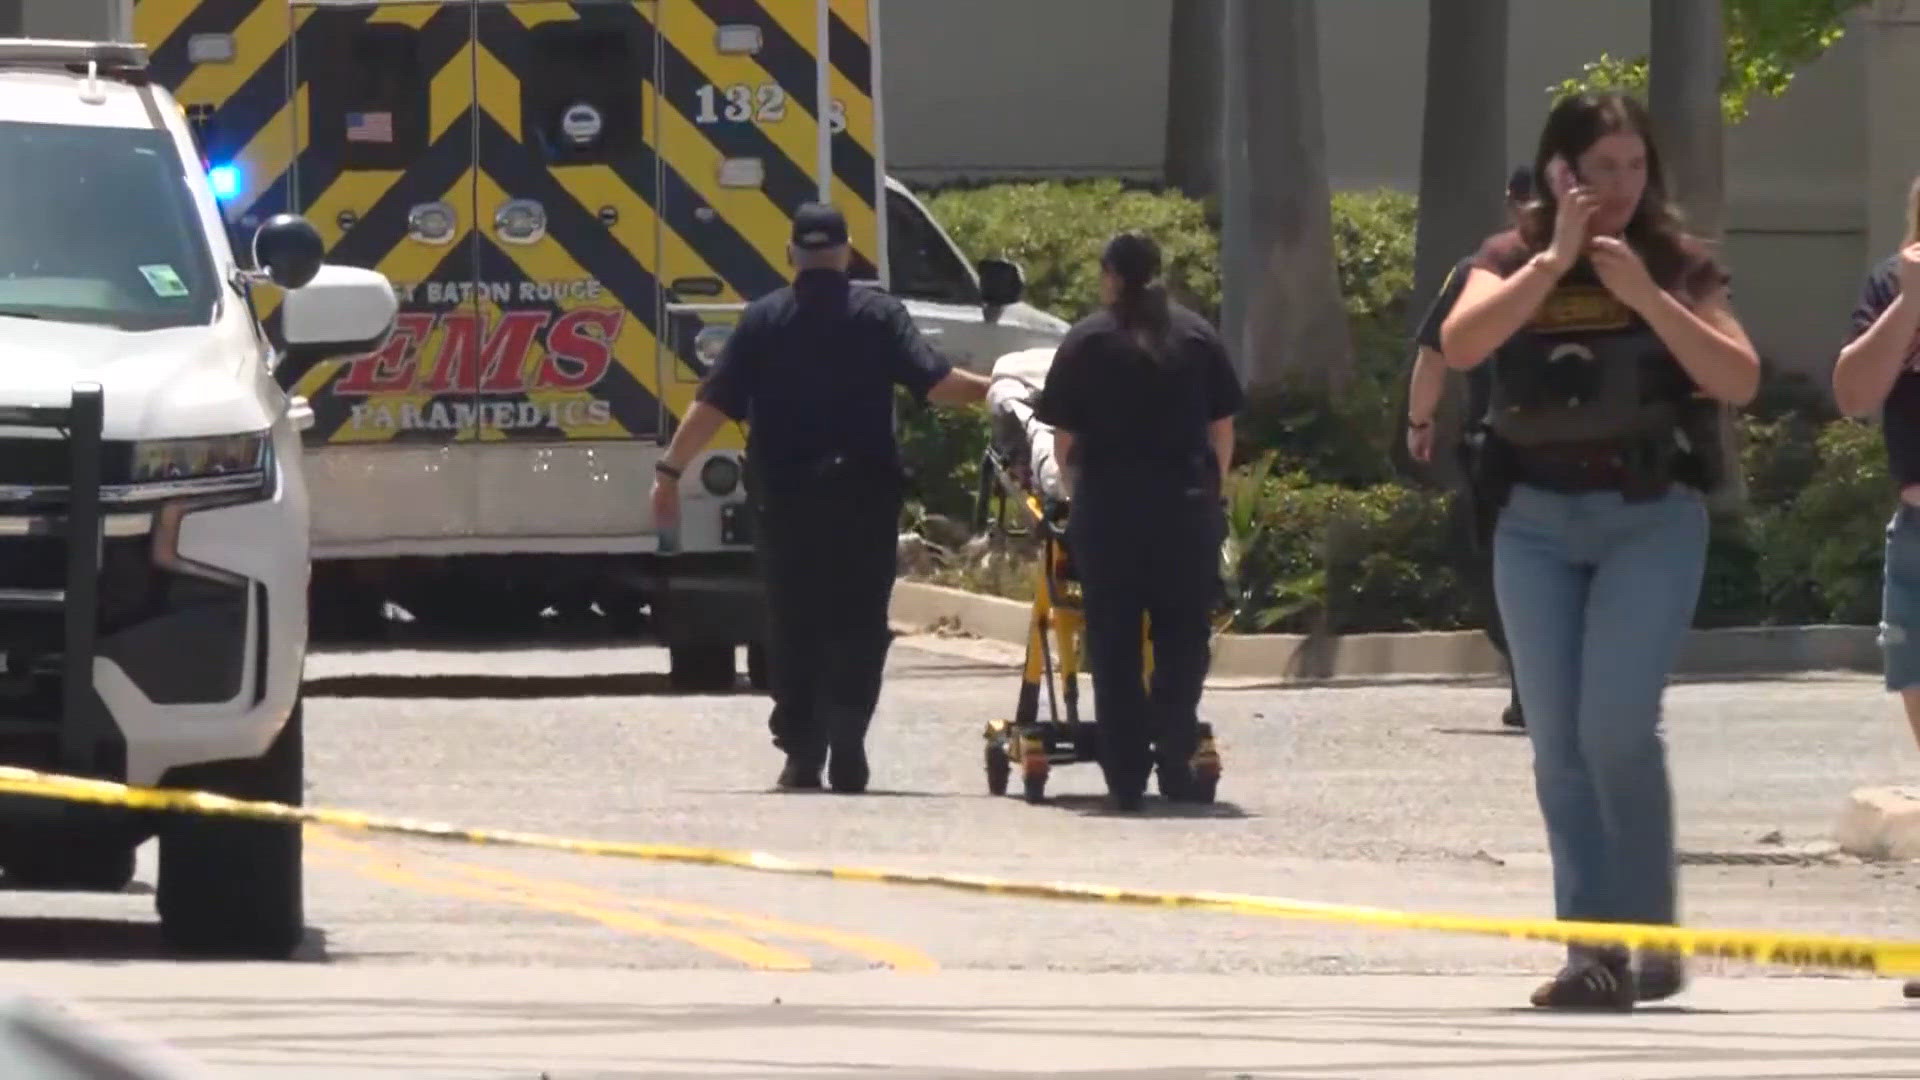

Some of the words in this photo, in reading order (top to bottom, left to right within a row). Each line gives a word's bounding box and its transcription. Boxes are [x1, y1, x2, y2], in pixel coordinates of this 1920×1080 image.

[695, 84, 786, 124] 132
[426, 282, 511, 302] BATON
[519, 280, 602, 301] ROUGE
[332, 307, 624, 395] EMS
[351, 400, 611, 431] PARAMEDICS
